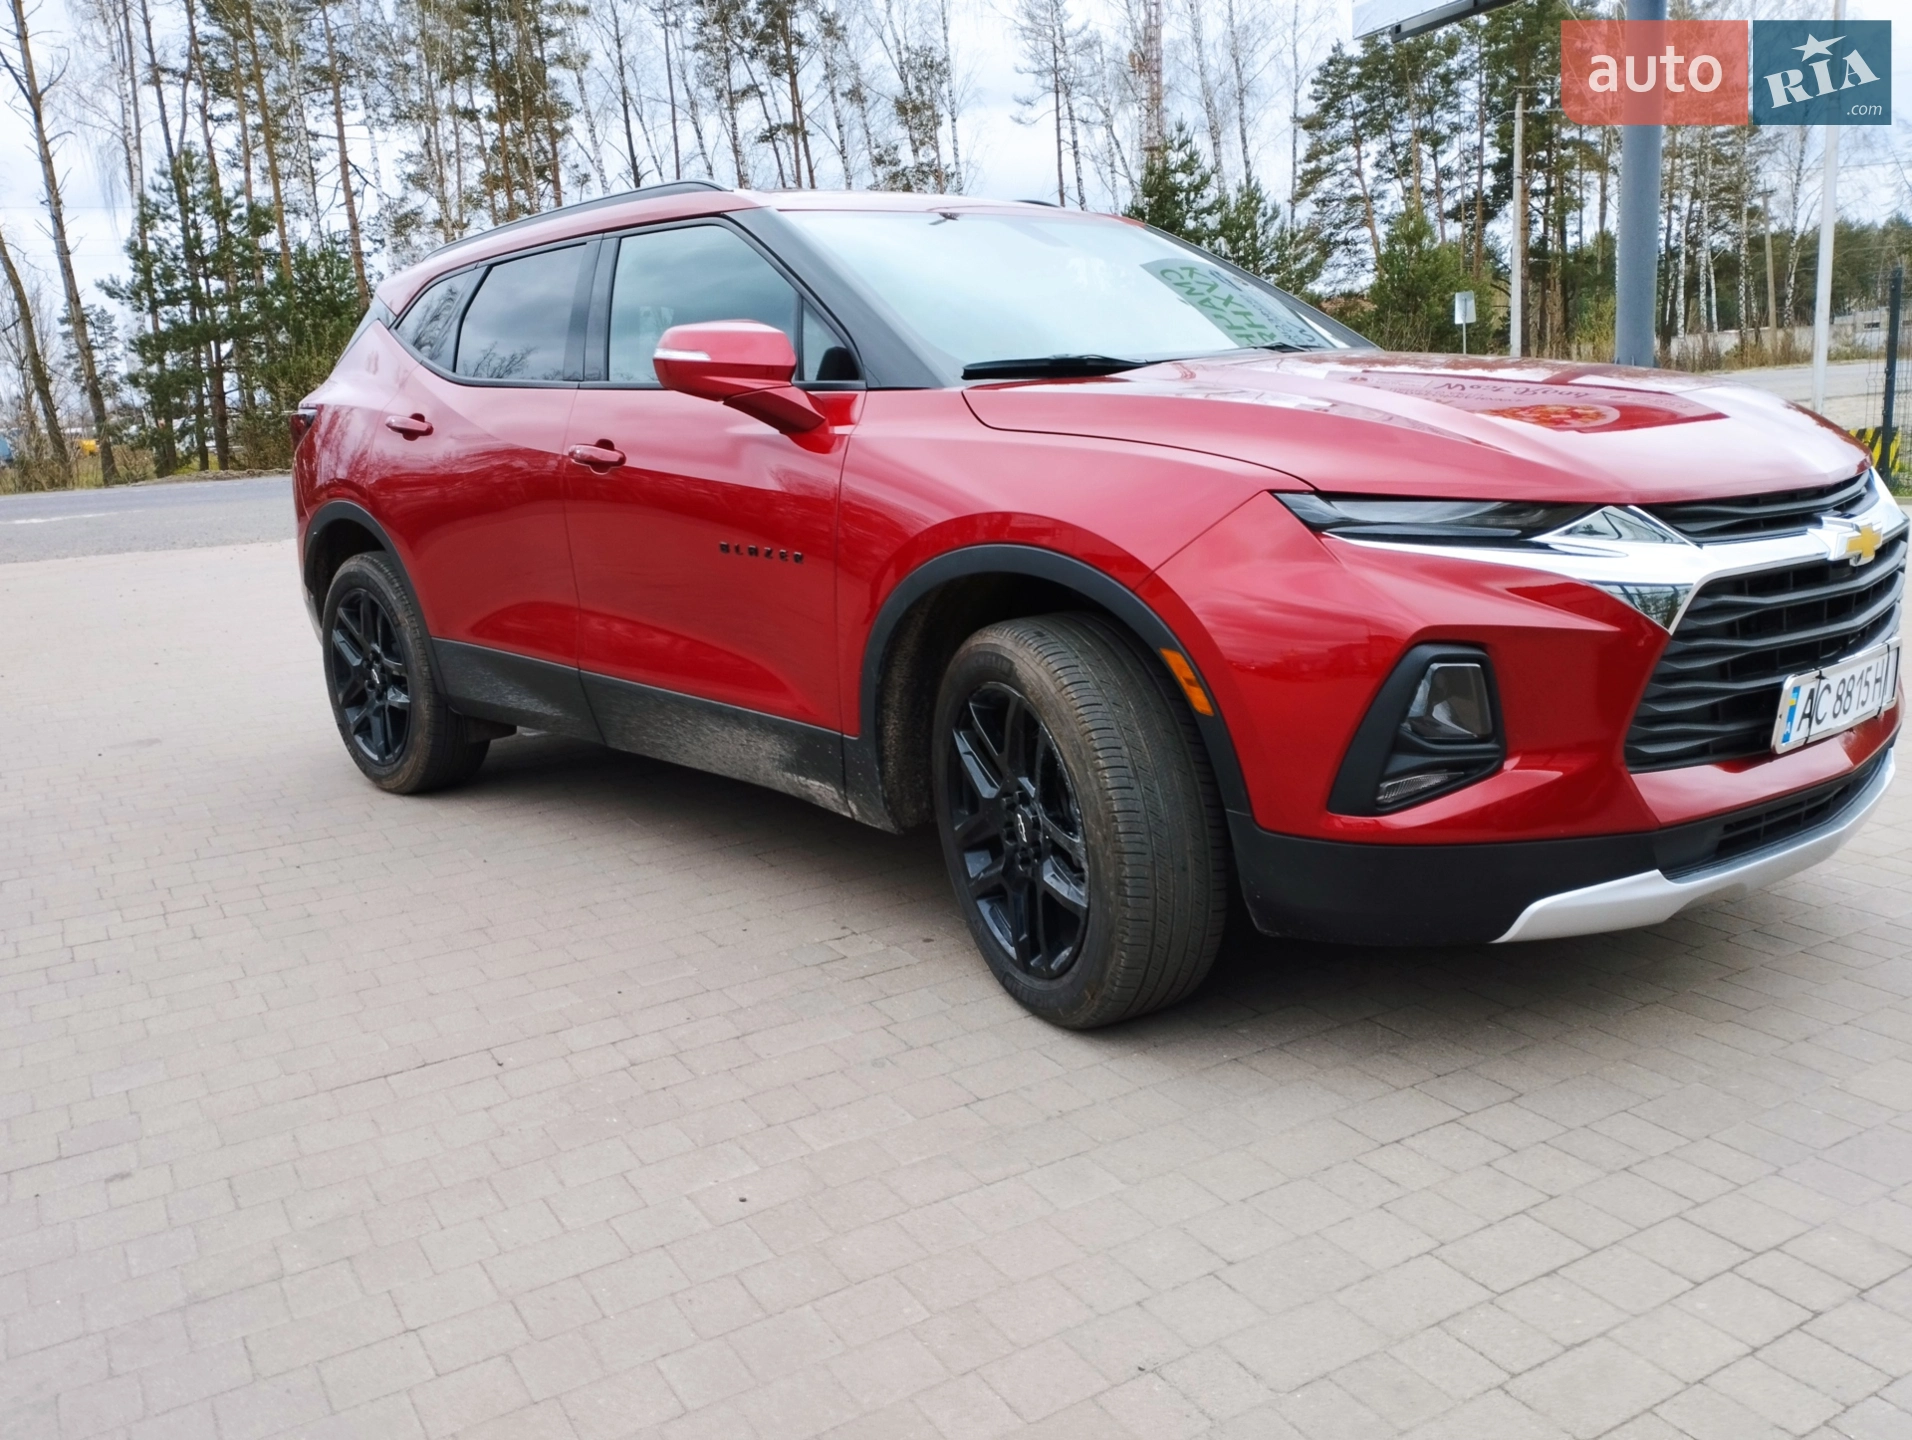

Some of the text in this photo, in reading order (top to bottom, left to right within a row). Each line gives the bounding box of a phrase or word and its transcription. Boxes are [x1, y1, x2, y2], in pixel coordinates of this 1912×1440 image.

[719, 542, 804, 564] BLAZER
[1796, 683, 1832, 732] AC
[1832, 665, 1873, 719] 8815
